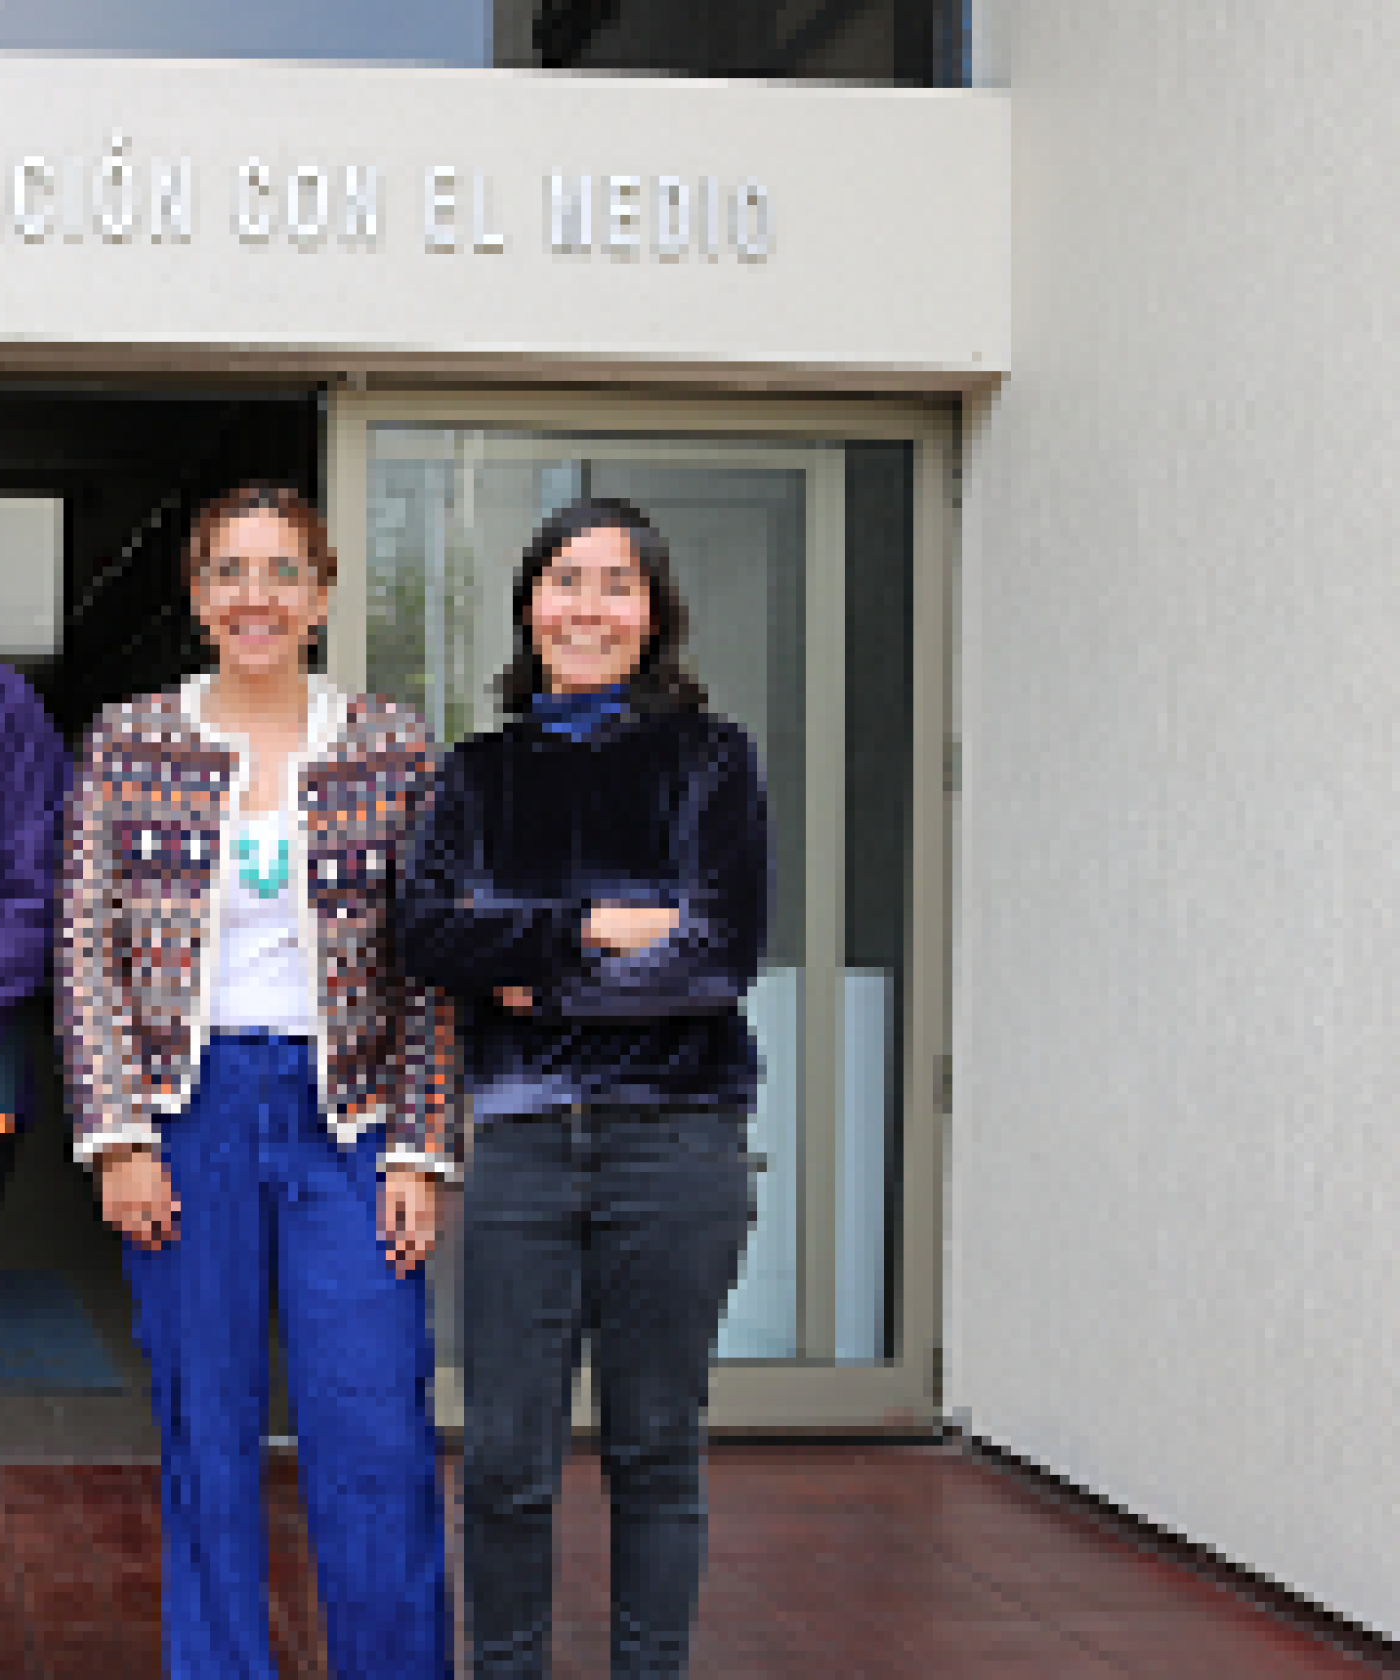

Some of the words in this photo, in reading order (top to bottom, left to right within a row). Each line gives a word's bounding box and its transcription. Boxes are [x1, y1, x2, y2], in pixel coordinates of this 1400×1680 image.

[232, 156, 384, 253] CON
[425, 166, 506, 253] EL
[543, 166, 776, 263] MEDIO
